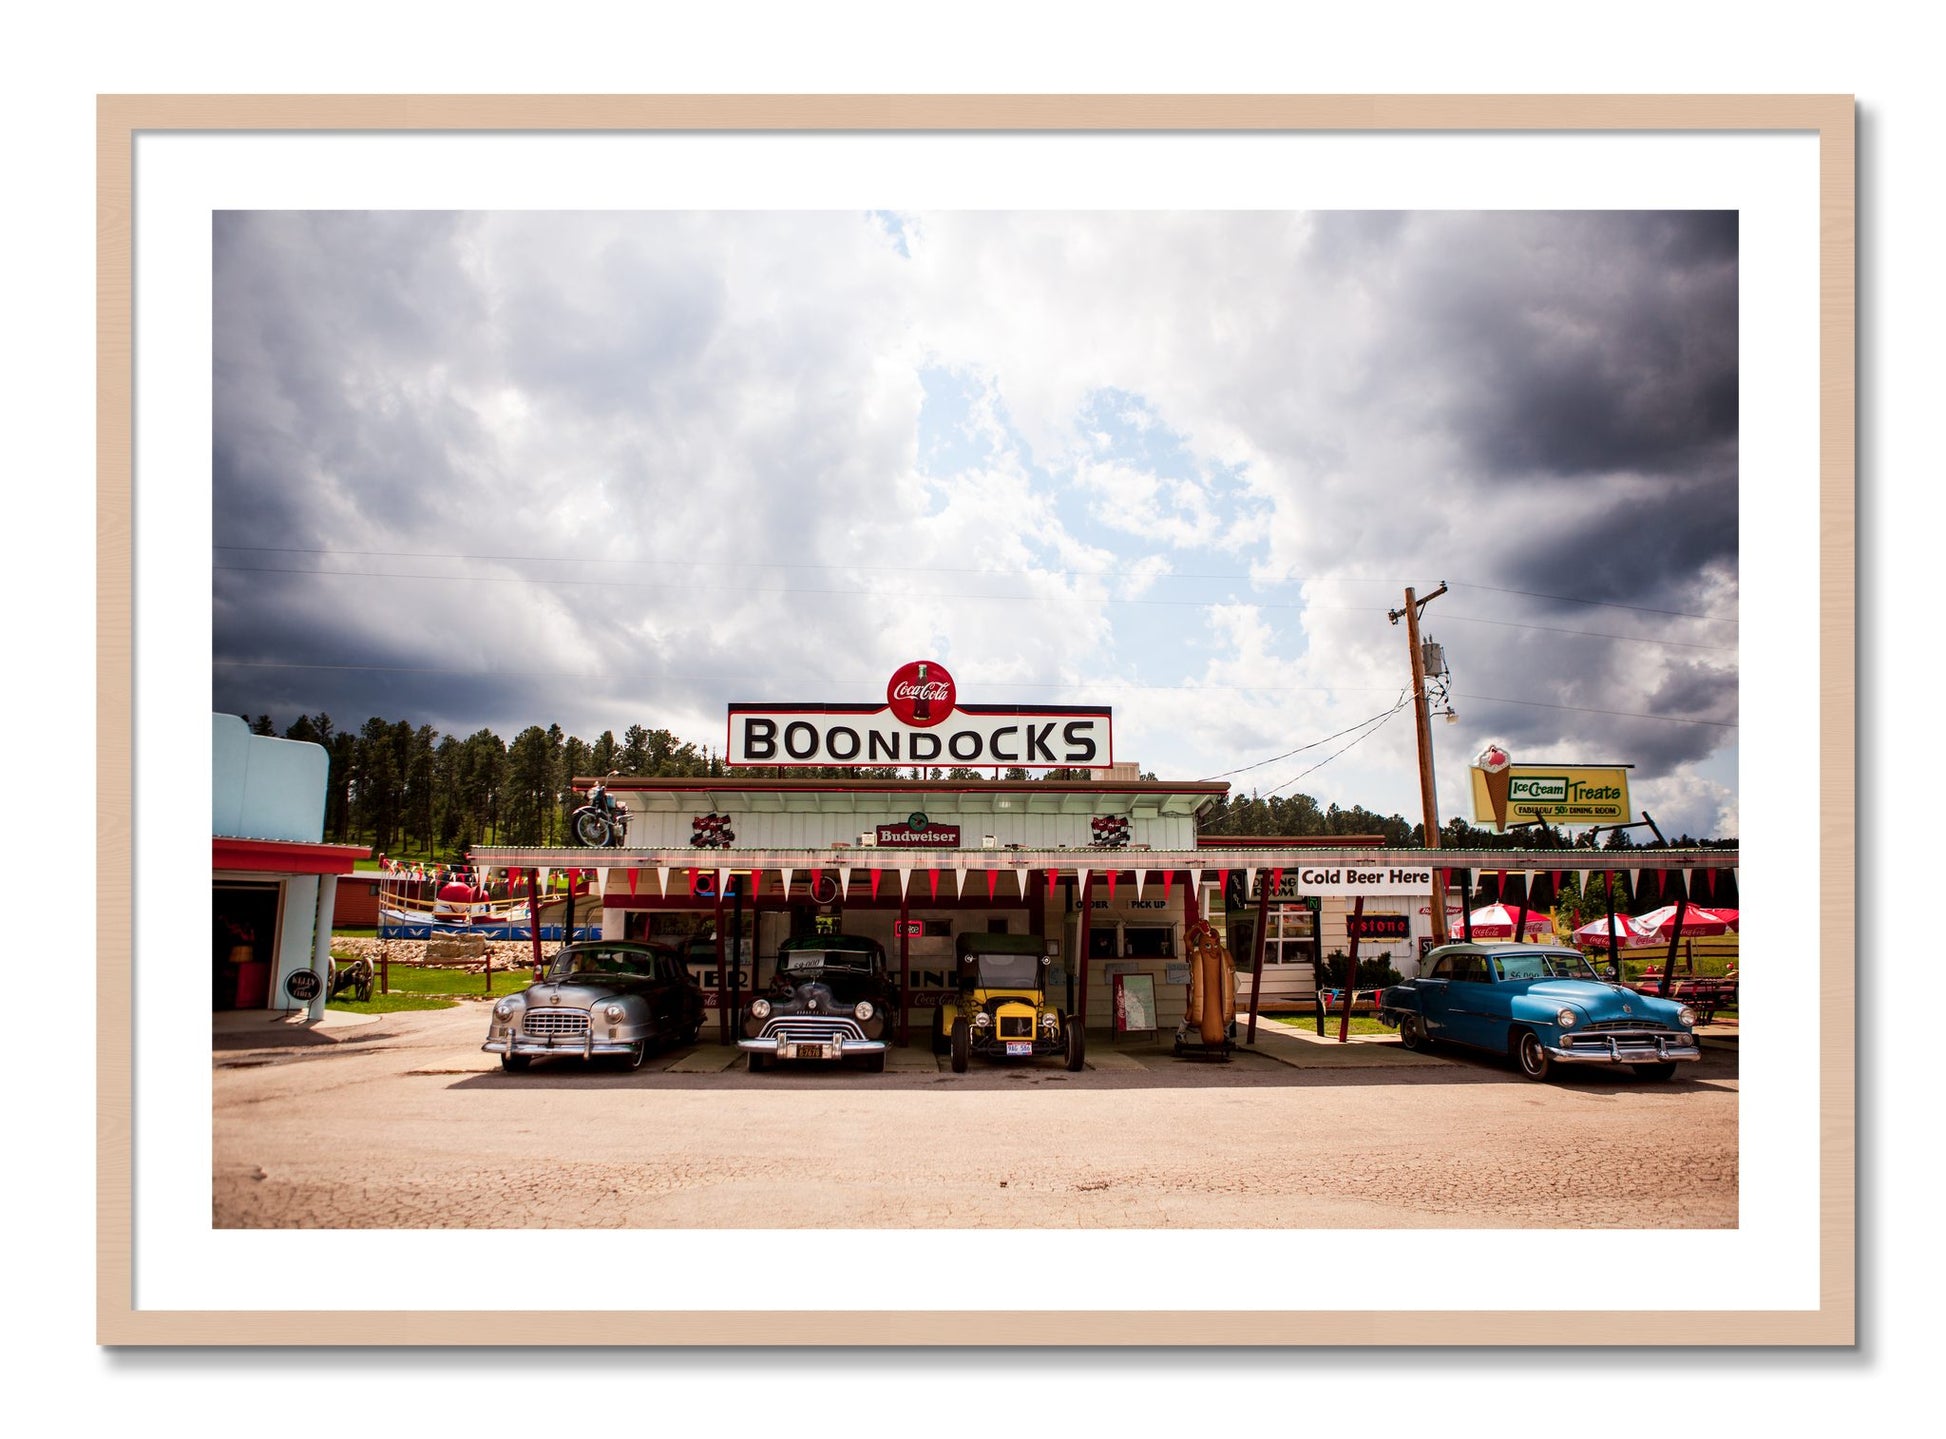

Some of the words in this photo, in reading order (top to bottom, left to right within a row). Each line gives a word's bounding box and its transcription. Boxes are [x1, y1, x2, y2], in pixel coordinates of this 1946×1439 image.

[893, 680, 951, 702] Coca-Cola
[744, 718, 1096, 762] BOONDOCKS
[1513, 782, 1528, 794] Ice
[1528, 782, 1564, 797] Cream
[1569, 781, 1620, 802] Treats
[1569, 806, 1593, 815] DINING
[1594, 806, 1616, 815] ROOM
[880, 830, 956, 842] Budweiser
[1301, 869, 1341, 885] Cold
[1346, 870, 1385, 885] Beer
[1389, 869, 1430, 884] Here
[1076, 900, 1109, 909] ODER
[1131, 900, 1152, 909] PICK
[1154, 900, 1167, 909] UP
[1350, 919, 1406, 933] stone
[1472, 926, 1499, 938] Coca-Cola
